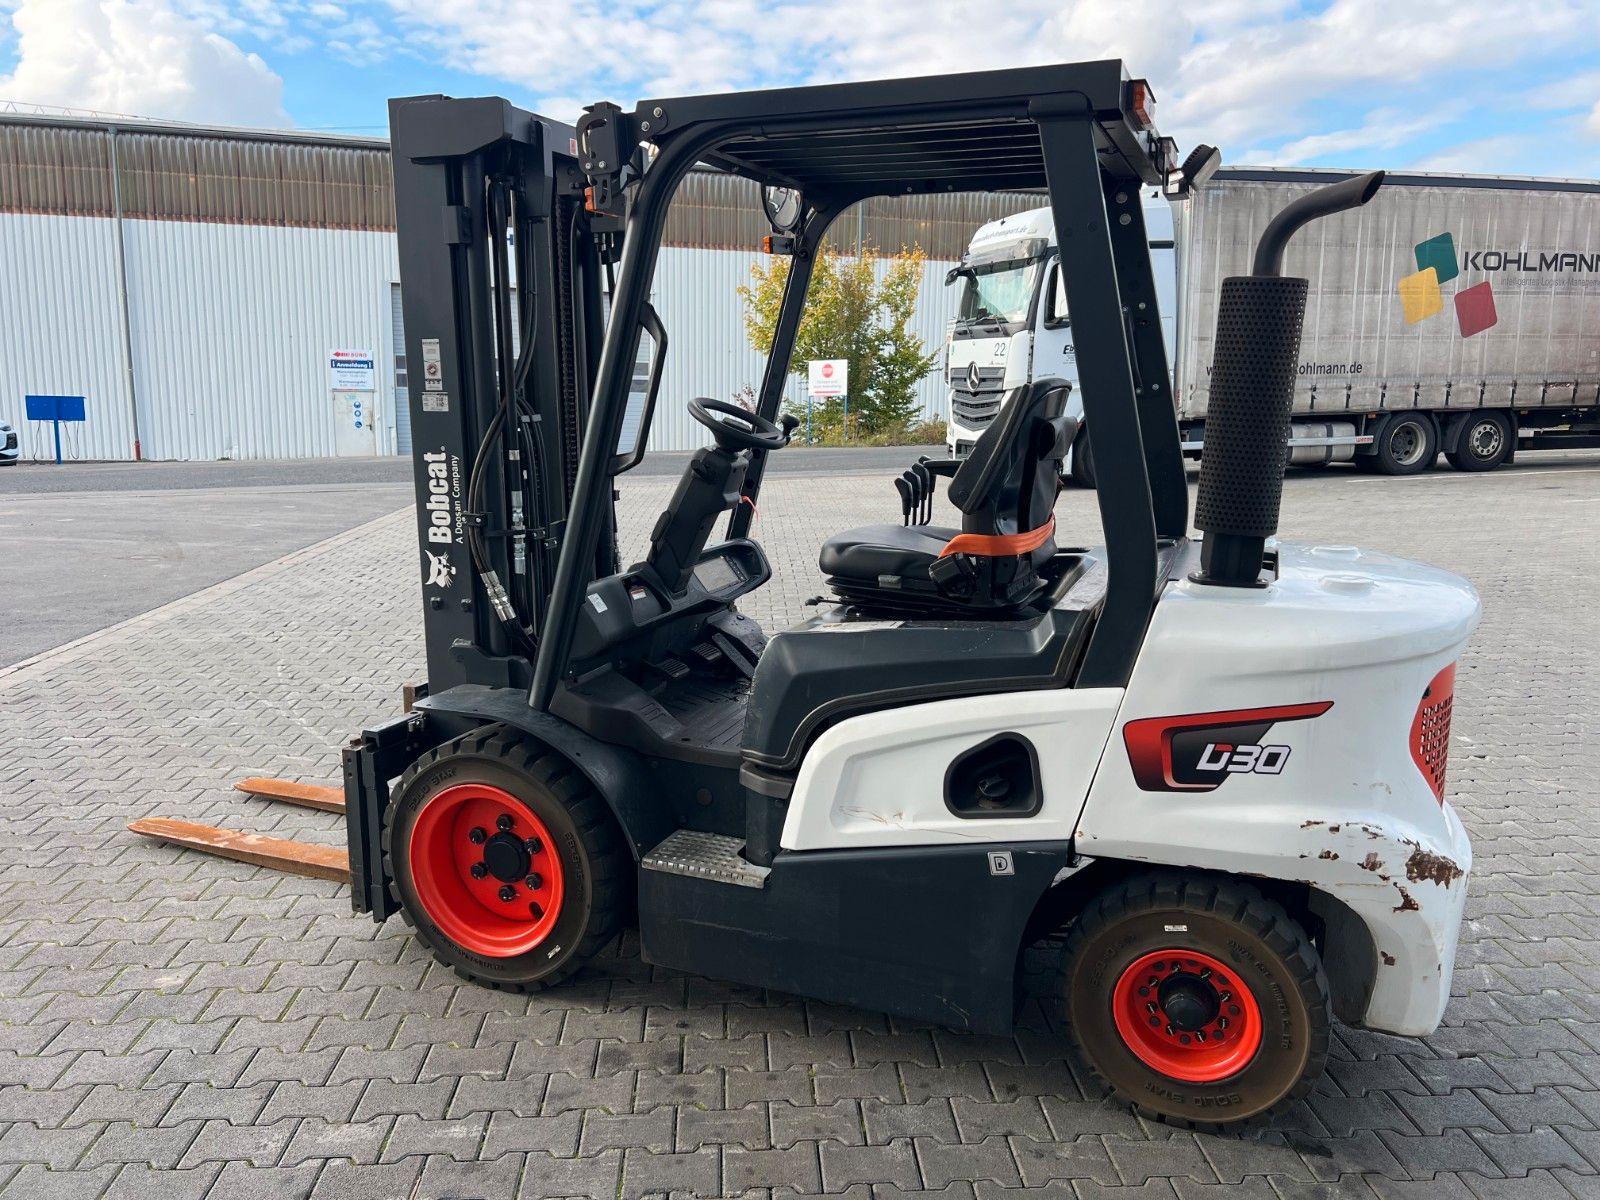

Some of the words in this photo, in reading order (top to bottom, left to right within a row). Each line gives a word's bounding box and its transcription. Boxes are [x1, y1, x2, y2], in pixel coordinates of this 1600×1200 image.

[336, 361, 369, 369] Anmeldung
[994, 342, 1006, 357] 22
[451, 454, 461, 498] Company
[423, 451, 453, 545] Bobcat
[453, 500, 463, 535] Doosan
[455, 536, 464, 544] A
[1195, 743, 1292, 775] D30
